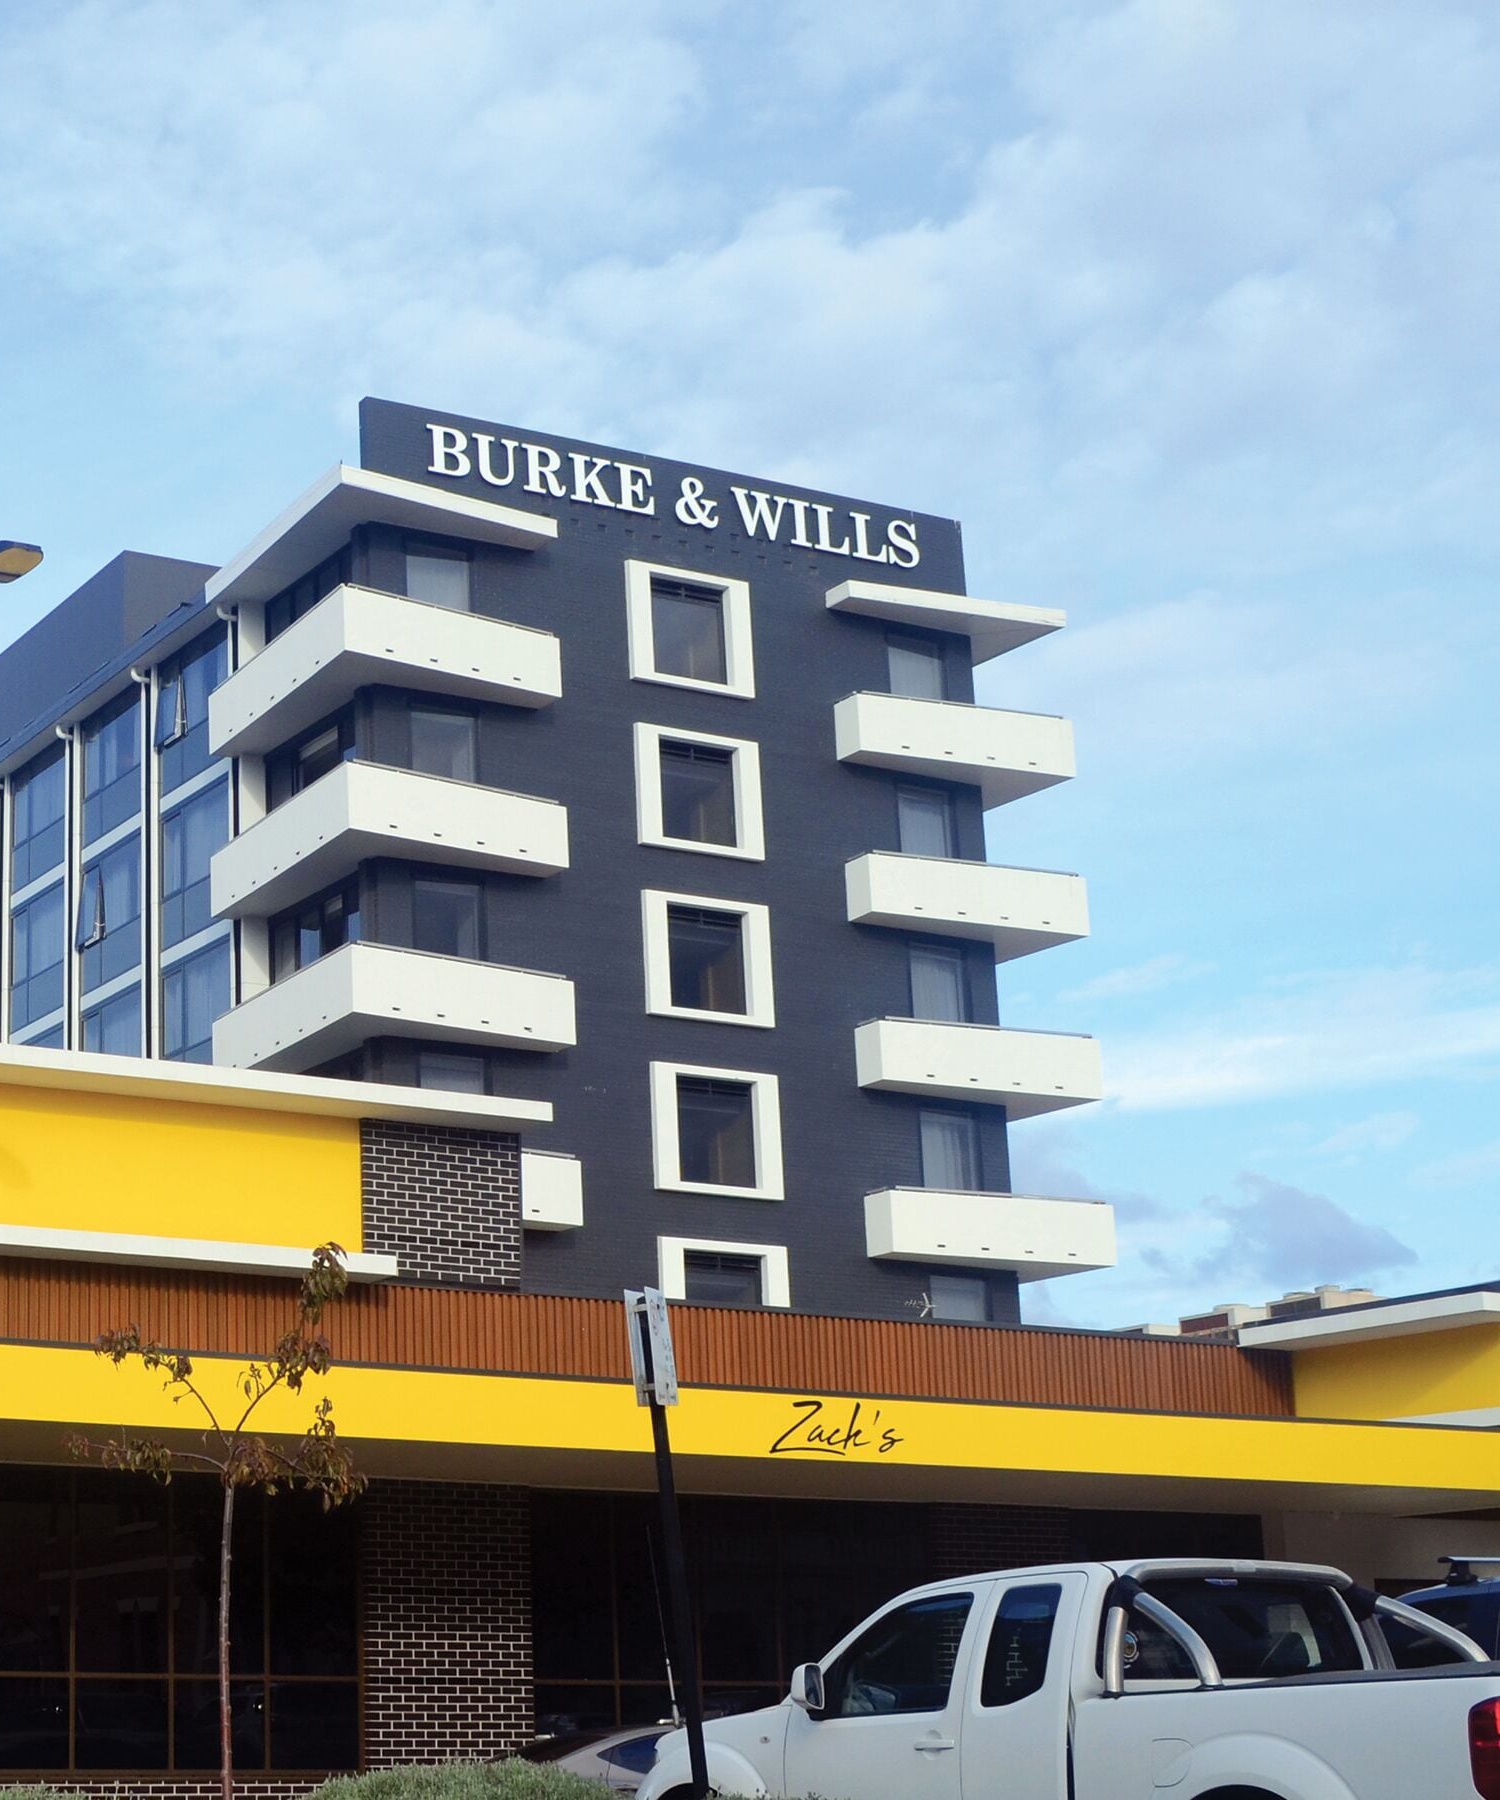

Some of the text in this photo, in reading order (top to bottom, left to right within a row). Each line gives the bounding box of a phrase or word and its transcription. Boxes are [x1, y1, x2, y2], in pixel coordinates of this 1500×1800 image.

[426, 424, 920, 569] BURKE & WILLS
[769, 1400, 904, 1456] Zack's
